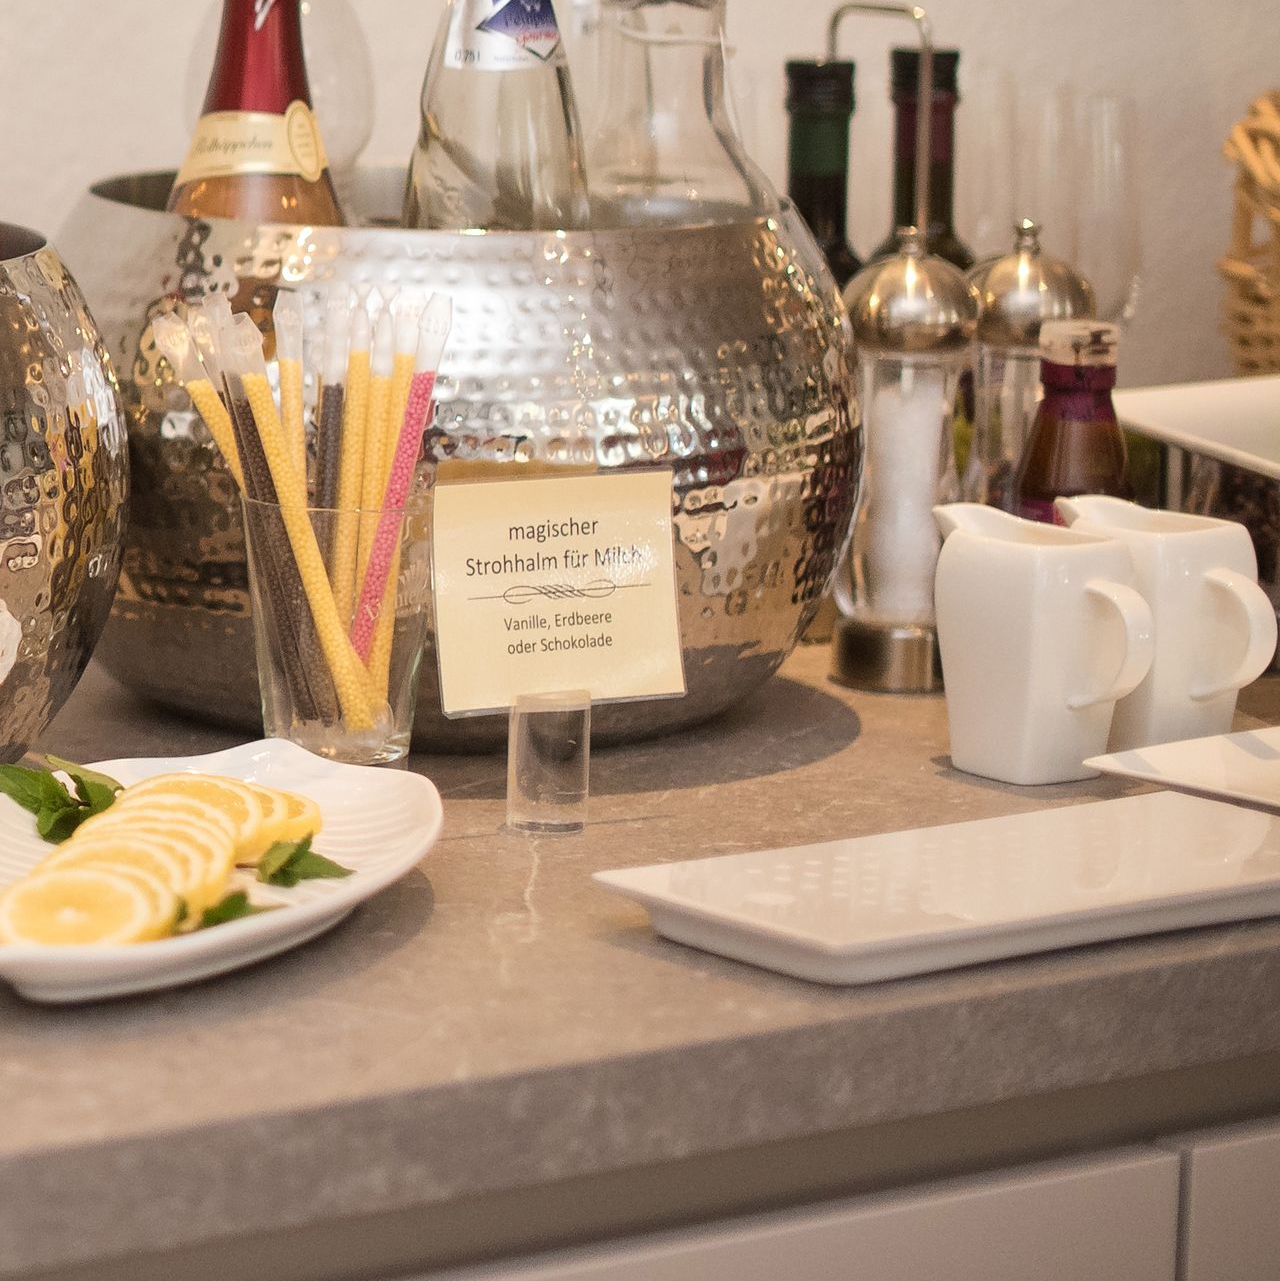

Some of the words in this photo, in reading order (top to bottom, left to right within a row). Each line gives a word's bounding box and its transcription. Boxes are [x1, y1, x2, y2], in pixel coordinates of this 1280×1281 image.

[509, 517, 599, 543] magischer
[466, 552, 558, 576] Strohhalm
[563, 549, 589, 569] für
[594, 544, 642, 566] Milch
[504, 615, 551, 631] Vanille,
[555, 611, 612, 628] Erdbeere
[507, 640, 537, 655] oder
[540, 632, 613, 652] Schokolade
